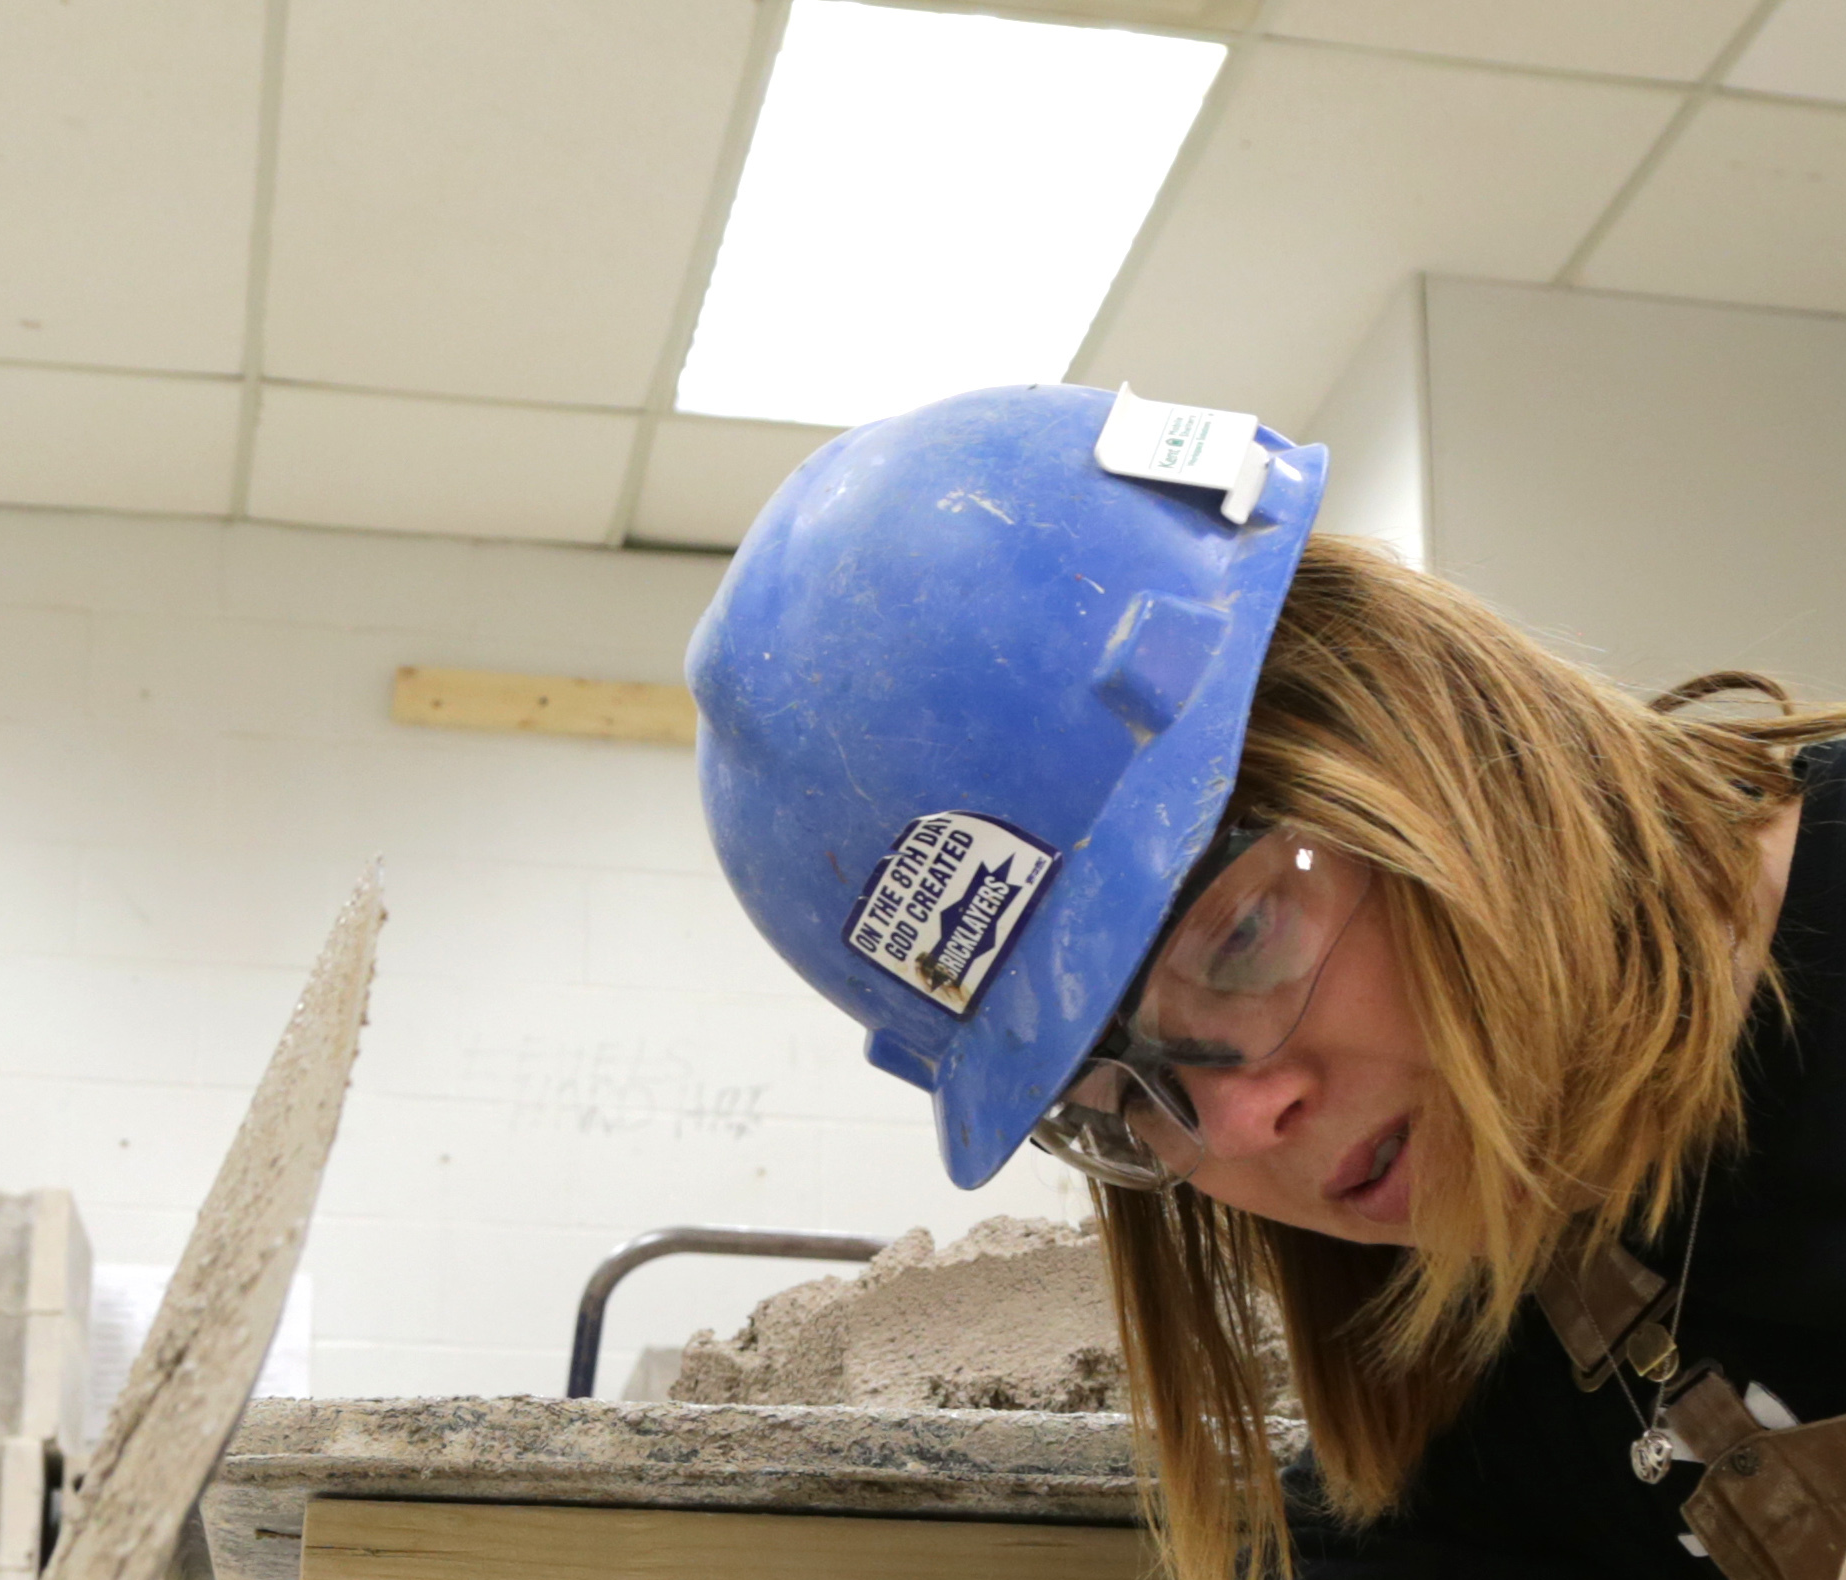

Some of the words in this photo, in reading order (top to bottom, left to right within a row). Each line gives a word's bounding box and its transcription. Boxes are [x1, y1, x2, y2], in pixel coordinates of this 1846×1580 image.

[1158, 448, 1181, 469] Kent
[913, 816, 953, 848] DAY
[890, 845, 929, 890] 8TH
[869, 885, 905, 928] THE
[884, 920, 919, 962] GOD
[905, 829, 975, 924] CREATED
[855, 921, 884, 954] ON
[938, 875, 1010, 981] BRICKLAYERS
